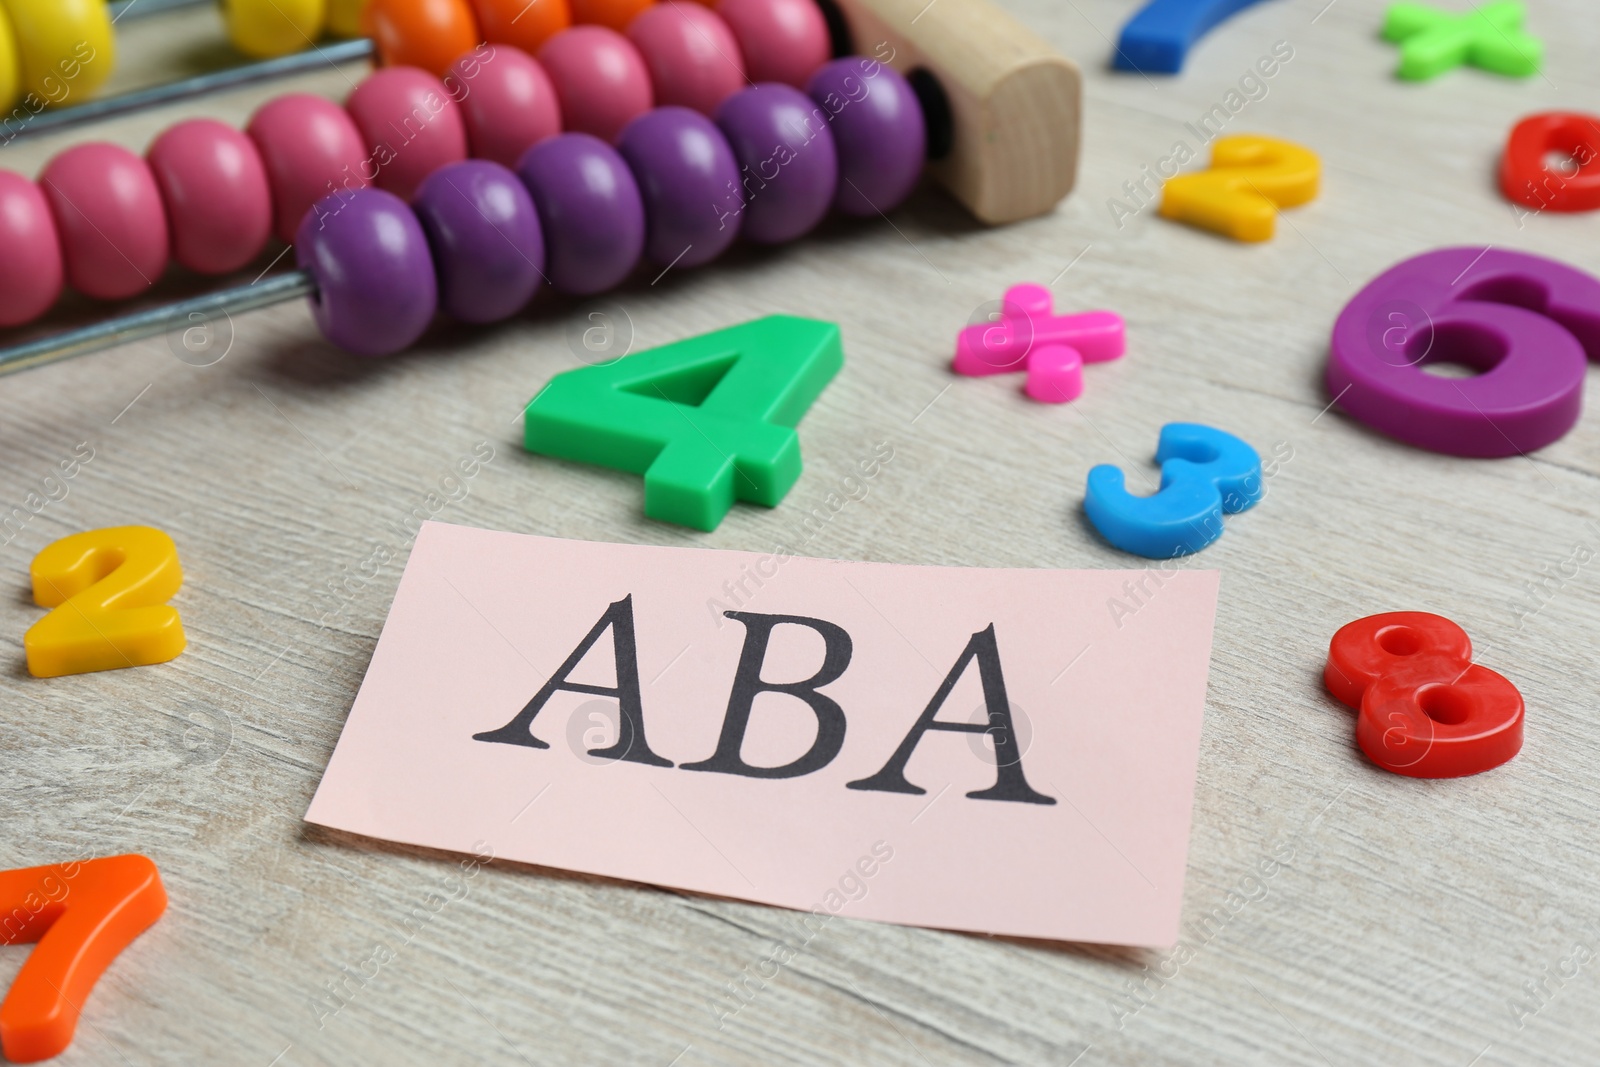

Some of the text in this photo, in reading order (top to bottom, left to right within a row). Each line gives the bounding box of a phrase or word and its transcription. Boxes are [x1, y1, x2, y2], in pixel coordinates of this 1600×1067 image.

[1157, 133, 1322, 244] 2
[524, 314, 844, 533] 4
[1328, 246, 1600, 458] 6
[1084, 422, 1262, 560] 3
[24, 525, 187, 679] 2
[1326, 611, 1525, 778] 8
[472, 593, 1058, 806] ABA
[0, 853, 168, 1063] 7
